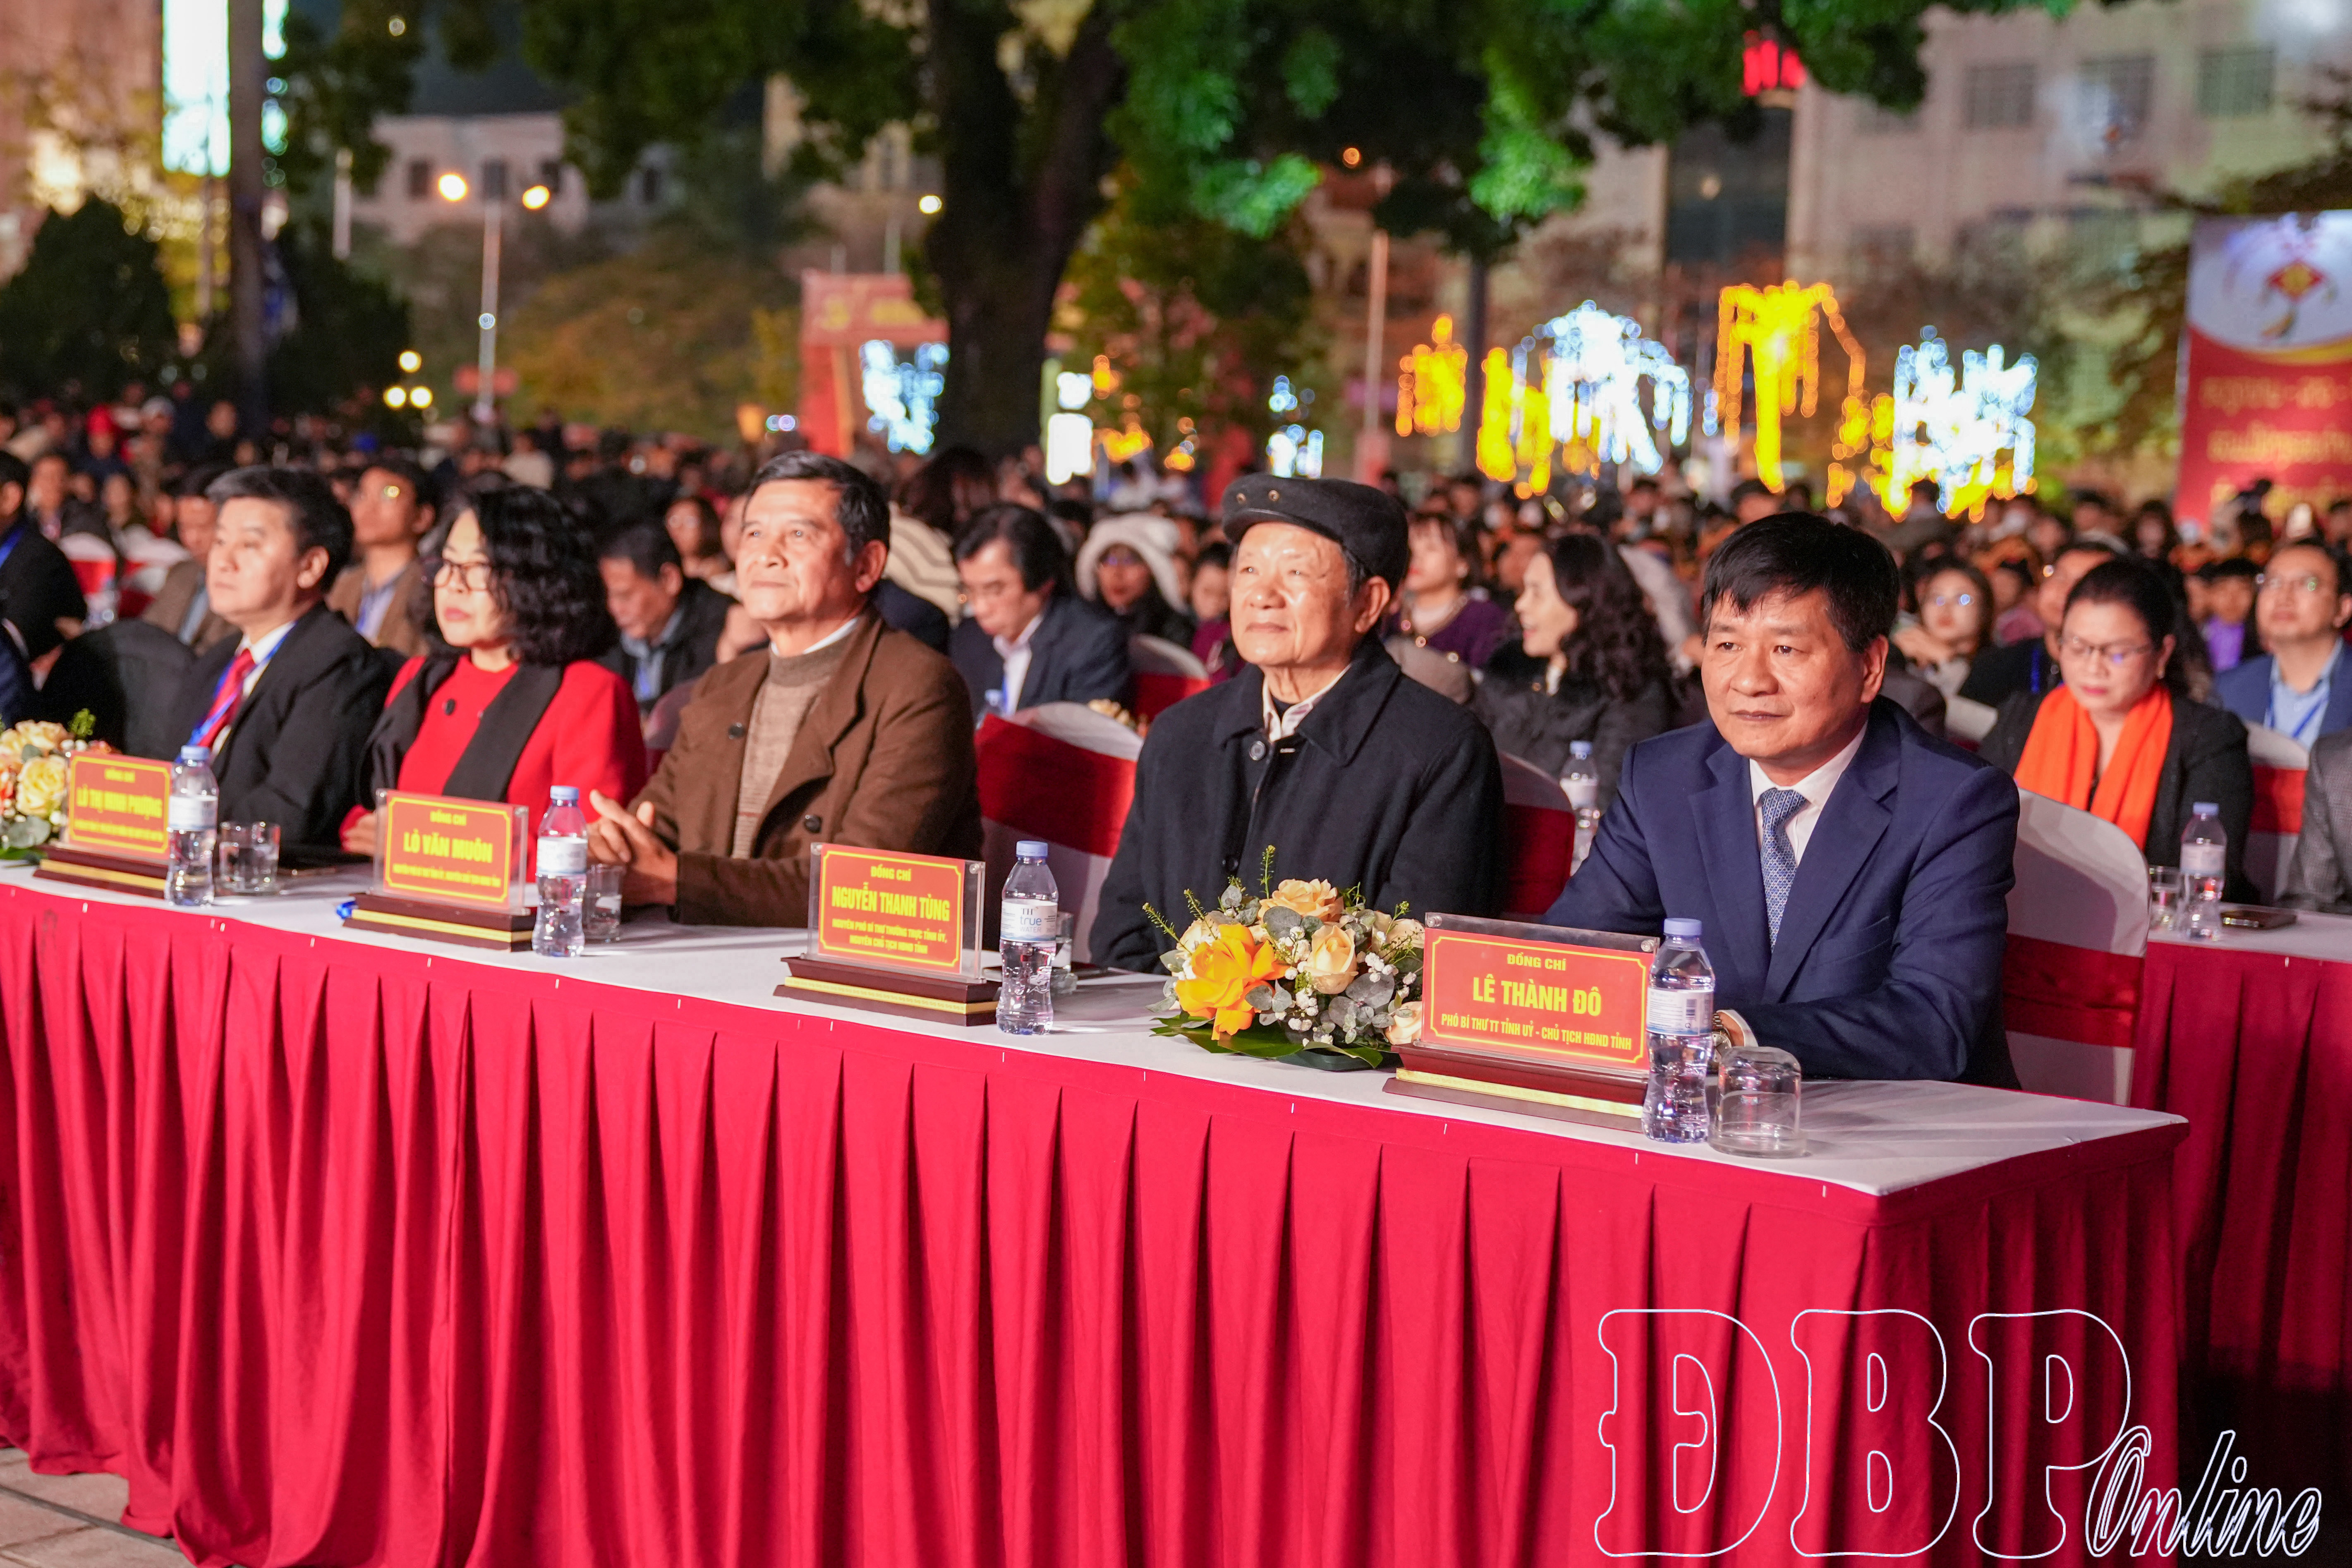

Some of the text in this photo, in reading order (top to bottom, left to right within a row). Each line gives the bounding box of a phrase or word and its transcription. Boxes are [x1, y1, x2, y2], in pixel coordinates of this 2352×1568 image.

[422, 832, 450, 857] VĂN
[451, 837, 493, 864] MUÔN
[896, 868, 912, 882] CHÍ
[831, 882, 951, 922] NGUYỄN THANH TÙNG
[1020, 916, 1042, 926] true
[1507, 952, 1567, 971] ĐỒNG CHÍ
[1473, 973, 1602, 1017] LÊ THÀNH ĐÔ
[1441, 1013, 1459, 1027] PHÓ
[1460, 1014, 1470, 1029] BÍ
[1471, 1017, 1489, 1031] THƯ
[1489, 1020, 1499, 1032] TT
[1500, 1017, 1521, 1036] TỈNH
[1541, 1024, 1559, 1041] CHỦ
[1561, 1029, 1582, 1045] TỊCH
[1583, 1032, 1609, 1047] HĐND
[1611, 1032, 1632, 1051] TỈNH
